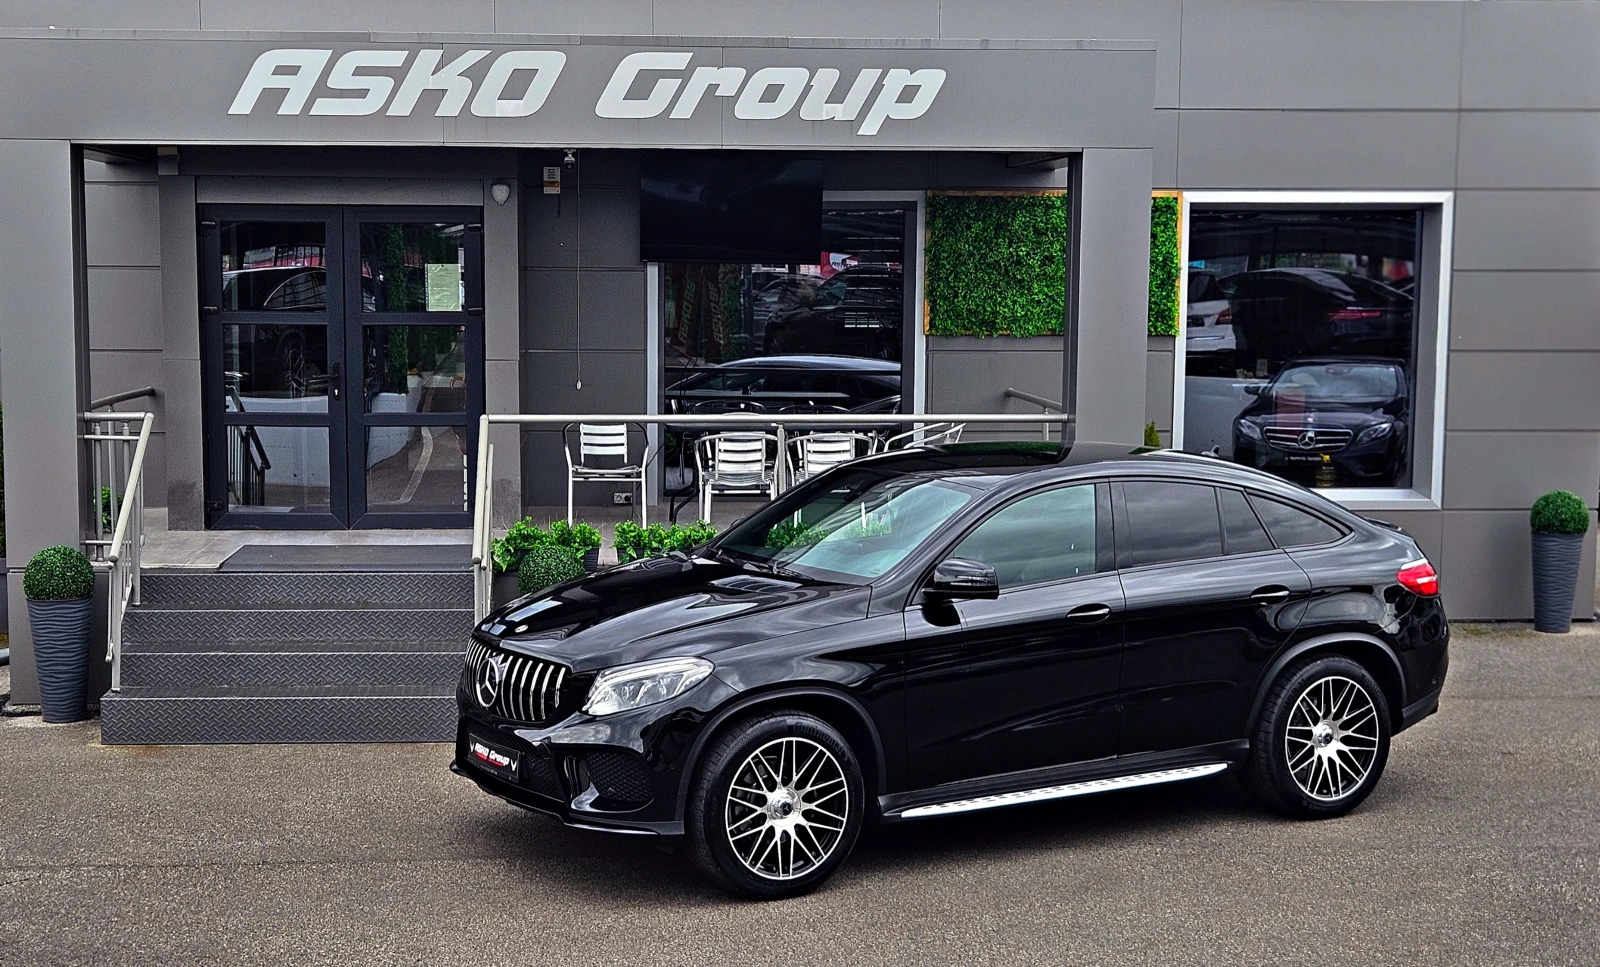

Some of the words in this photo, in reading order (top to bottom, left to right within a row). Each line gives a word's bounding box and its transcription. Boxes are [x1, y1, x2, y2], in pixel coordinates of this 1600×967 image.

[227, 49, 567, 117] ASKO
[594, 52, 947, 136] Group
[474, 742, 490, 757] ASKO
[488, 749, 510, 767] Group
[793, 722, 844, 756] Continental
